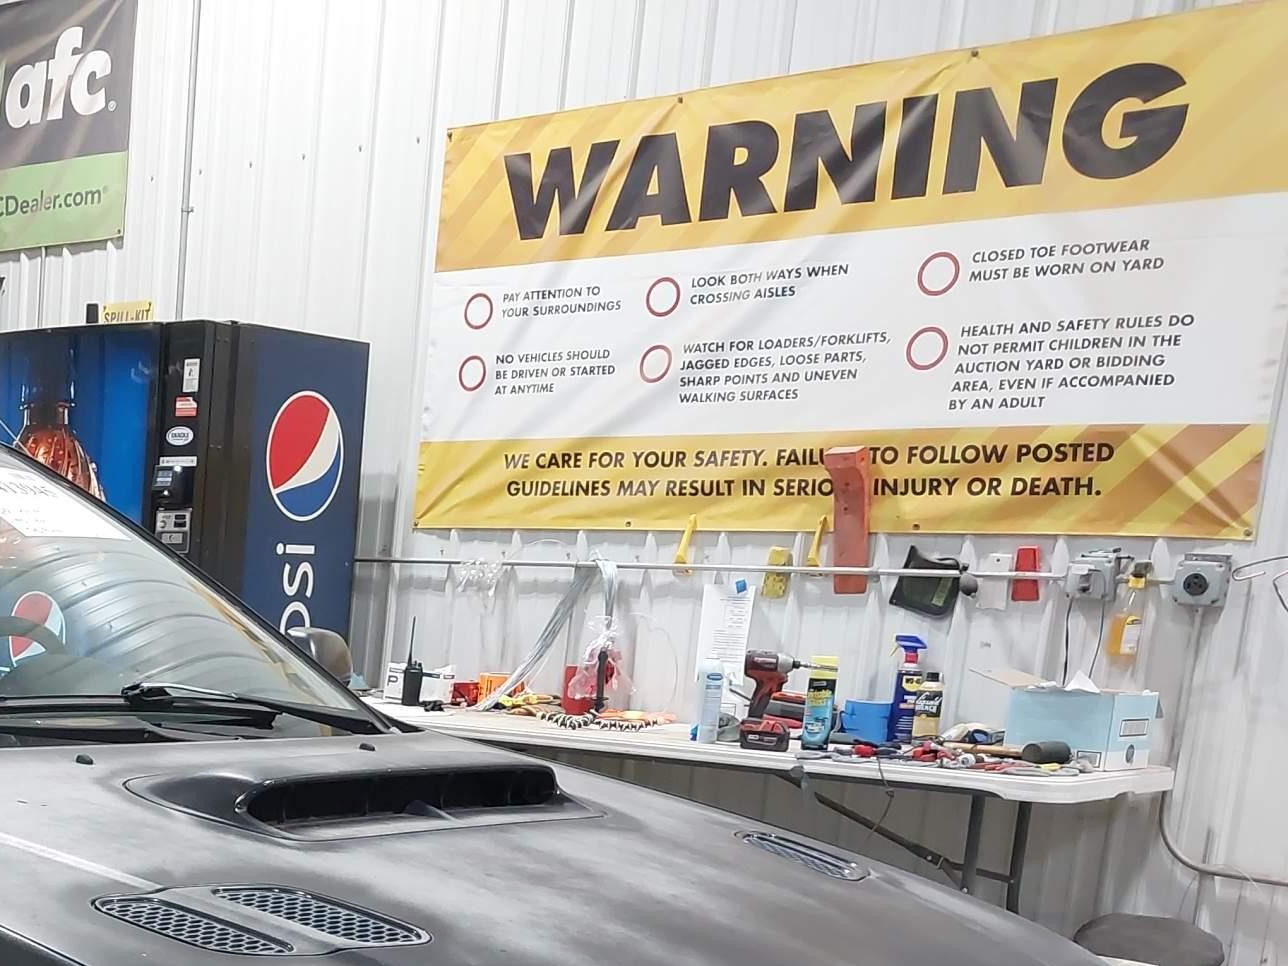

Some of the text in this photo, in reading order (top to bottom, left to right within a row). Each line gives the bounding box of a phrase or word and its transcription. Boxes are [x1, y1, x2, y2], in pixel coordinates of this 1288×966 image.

[504, 62, 1189, 241] WARNING
[972, 239, 1150, 264] CLOSED TOE FOOTWEAR
[691, 264, 849, 288] LOOK BOTH WAYS WHEN
[969, 257, 1164, 282] MUST BE WORN ON YARD
[503, 286, 601, 303] PAY ATTENTION TO
[690, 286, 796, 305] CROSSING AISLES
[502, 300, 622, 318] YOUR SURROUNDINGS
[960, 314, 1195, 338] HEALTH AND SAFETY RULES DO
[683, 331, 891, 354] WATCH FOR LOADERS/FORKLIFTS,
[958, 334, 1182, 356] NOT PERMIT CHILDREN IN THE
[496, 349, 610, 365] NO VEHICLES SHOULD
[680, 351, 867, 371] JAGGED EDGES, LOOSE PARTS,
[954, 354, 1165, 375] AUCTION YARD OR BIDDING
[495, 365, 616, 380] BE DRIVEN OR STARTED
[680, 369, 858, 388] SHARP POINTS AND UNEVEN
[495, 383, 554, 395] AT ANYTIME
[951, 374, 1175, 393] AREA, EVEN IF ACCOMPANIED
[679, 389, 799, 404] WALKING SURFACES
[948, 396, 1045, 410] BY AN ADULT
[504, 453, 529, 469] WE
[535, 452, 582, 469] CARE
[588, 451, 624, 468] FOR
[632, 450, 687, 468] YOUR
[693, 448, 768, 467] SAFETY.
[869, 446, 898, 465] TO
[907, 444, 1007, 464] FOLLOW
[1016, 443, 1114, 463] POSTED
[507, 477, 1102, 497] GUIDELINES MAY RESULT IN SERIO INJURY OR DEATH.
